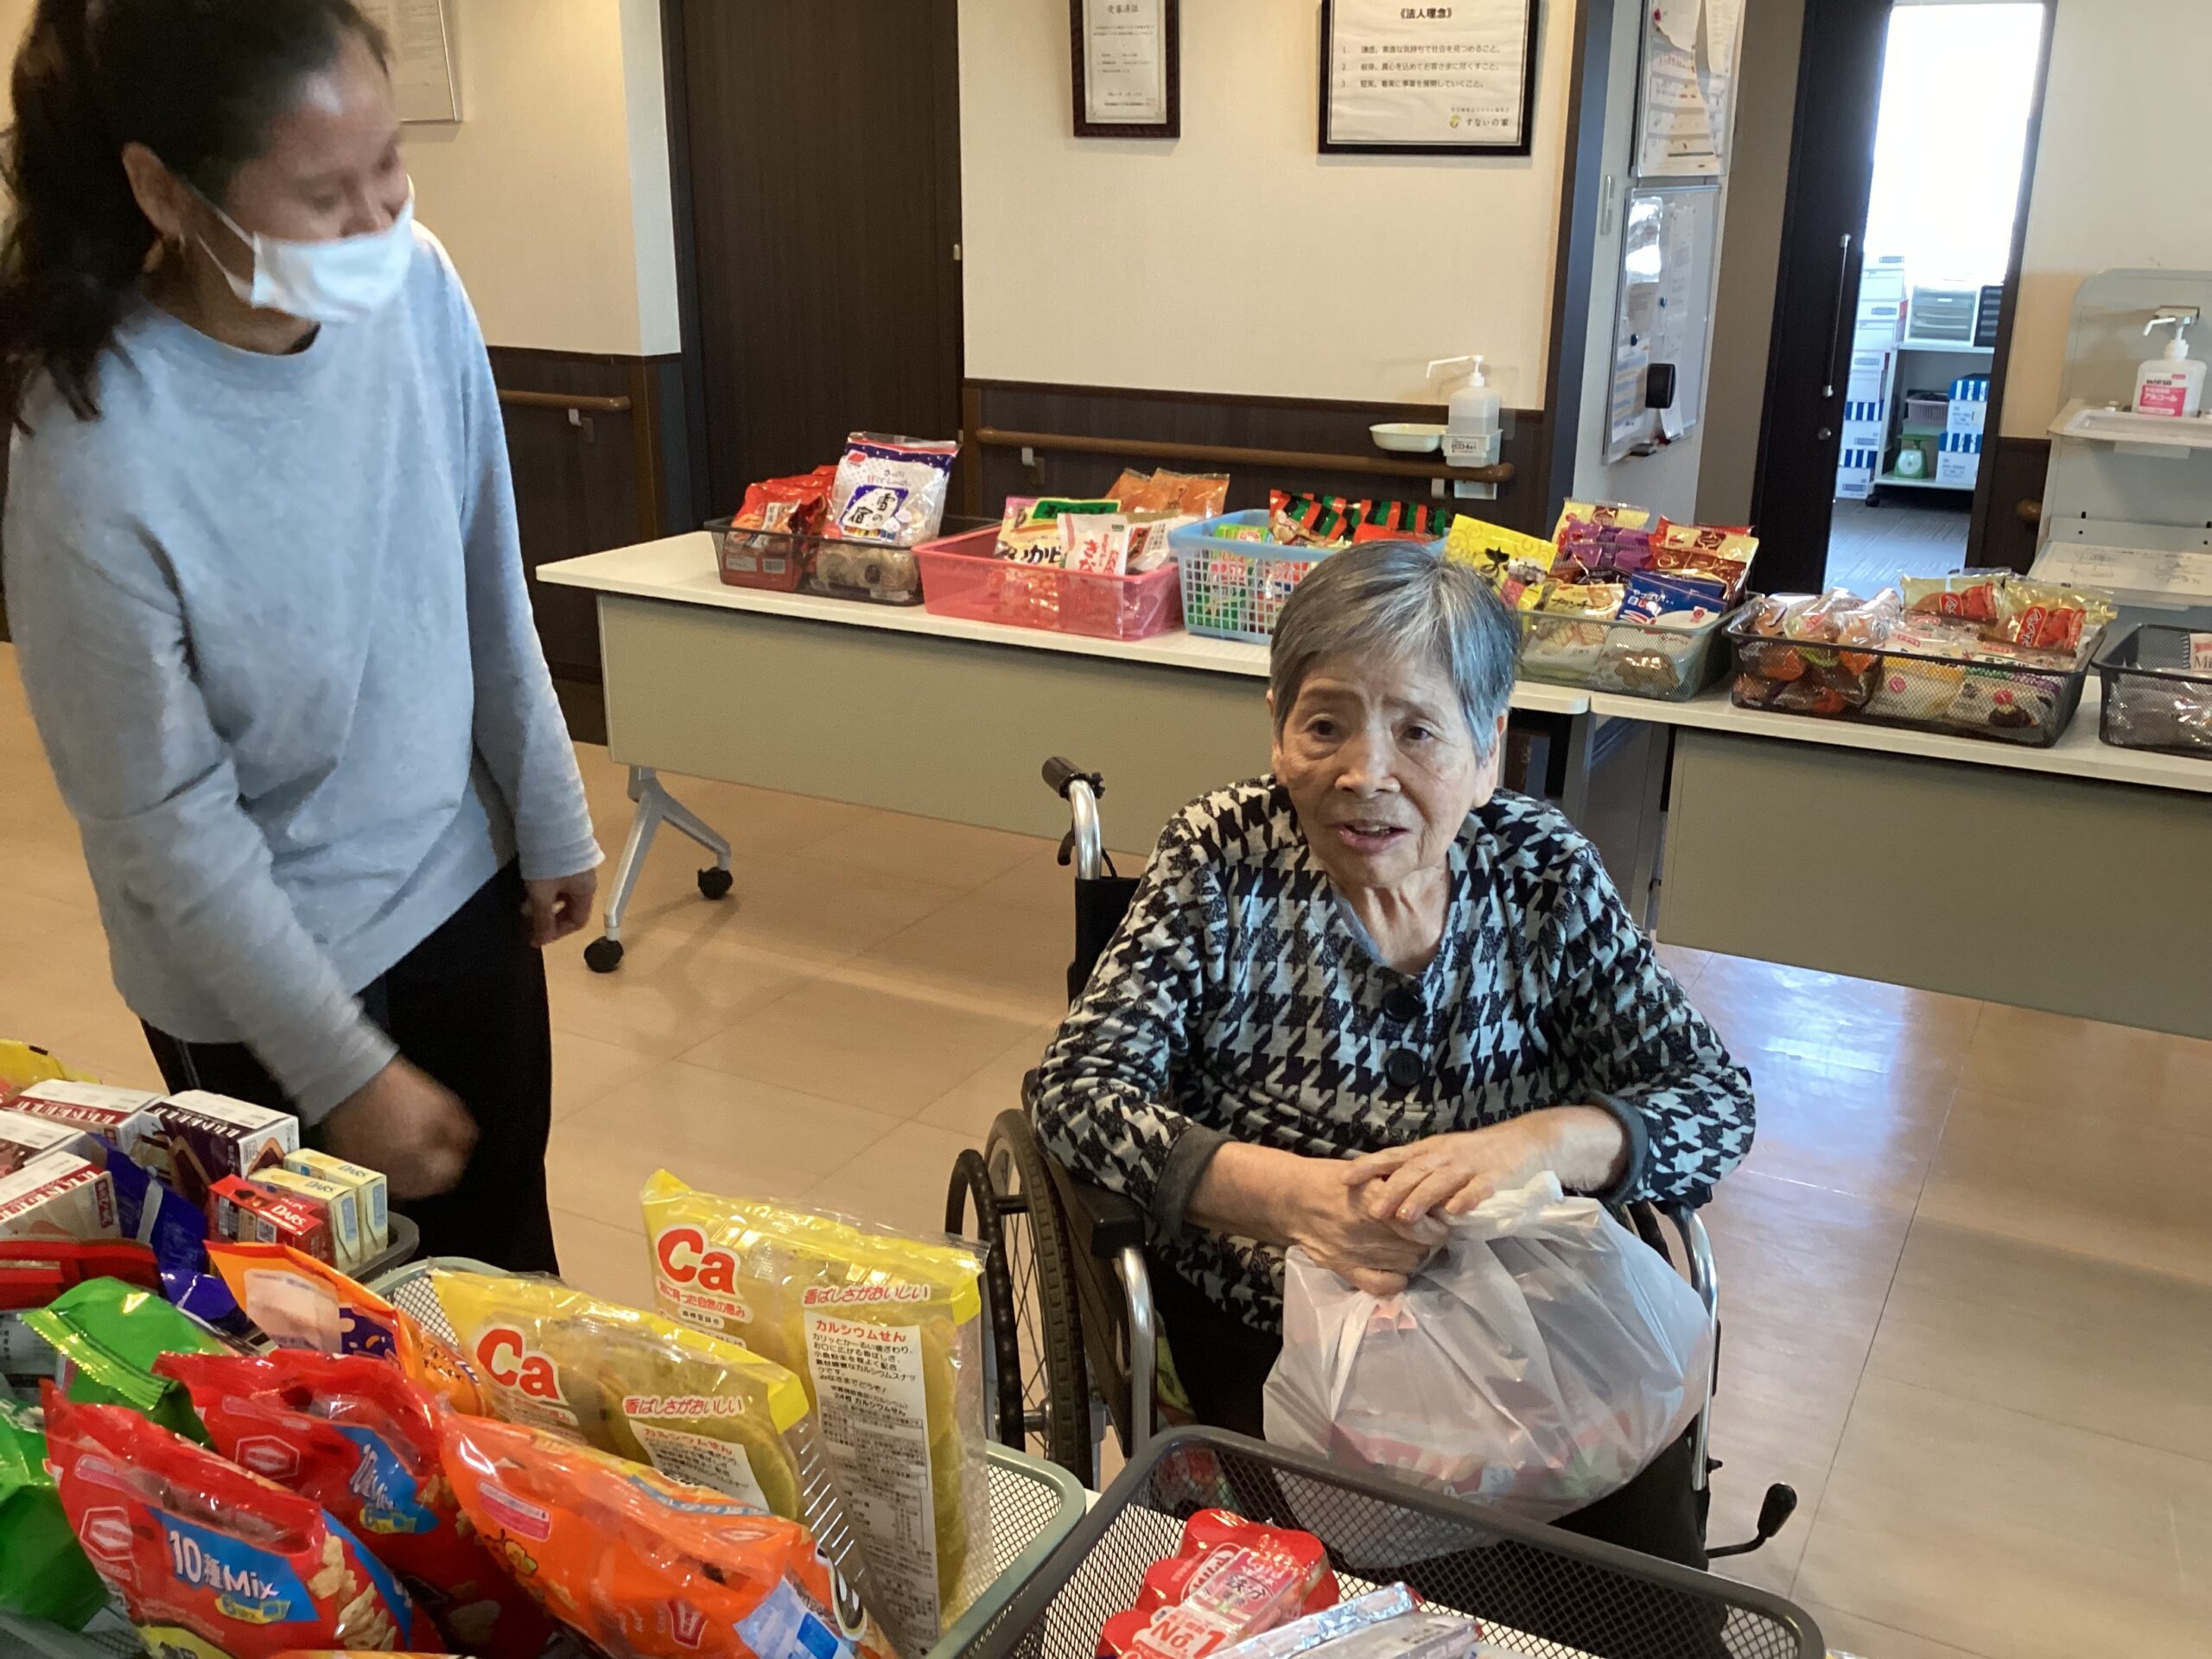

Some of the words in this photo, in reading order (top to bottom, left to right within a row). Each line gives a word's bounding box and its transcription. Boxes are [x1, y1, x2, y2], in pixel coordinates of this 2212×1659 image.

[338, 1164, 368, 1178] DARS
[304, 1179, 335, 1194] DARS
[270, 1204, 308, 1227] DARS
[658, 1228, 736, 1295] Ca
[804, 1286, 928, 1306] 香ばしさがおいしい
[816, 1319, 906, 1343] カルシウムせん
[476, 1328, 561, 1402] Ca
[624, 1396, 743, 1416] 香ばしさがおいしい
[168, 1529, 280, 1600] 10種Mix
